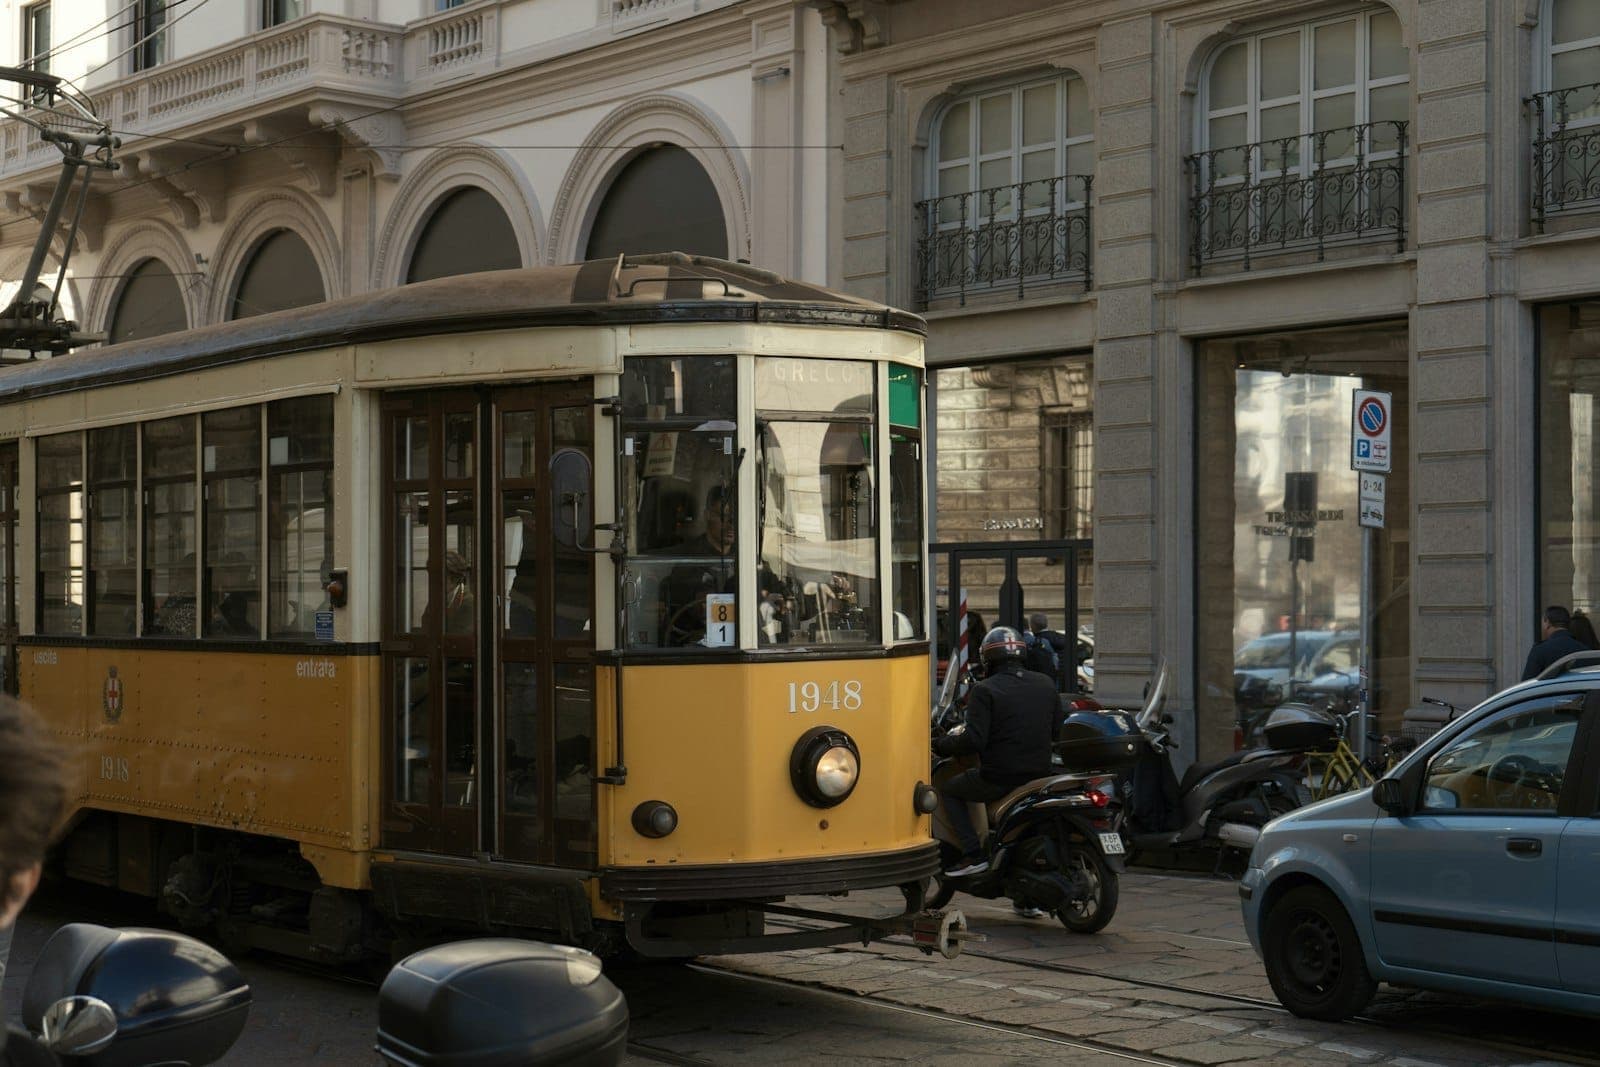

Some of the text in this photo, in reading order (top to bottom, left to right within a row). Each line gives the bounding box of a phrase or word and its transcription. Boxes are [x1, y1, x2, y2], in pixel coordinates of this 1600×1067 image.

[773, 360, 853, 384] GRECO
[1359, 441, 1368, 456] P
[718, 605, 727, 622] 8
[719, 625, 726, 642] 1
[296, 658, 336, 678] entrata
[787, 680, 863, 714] 1948
